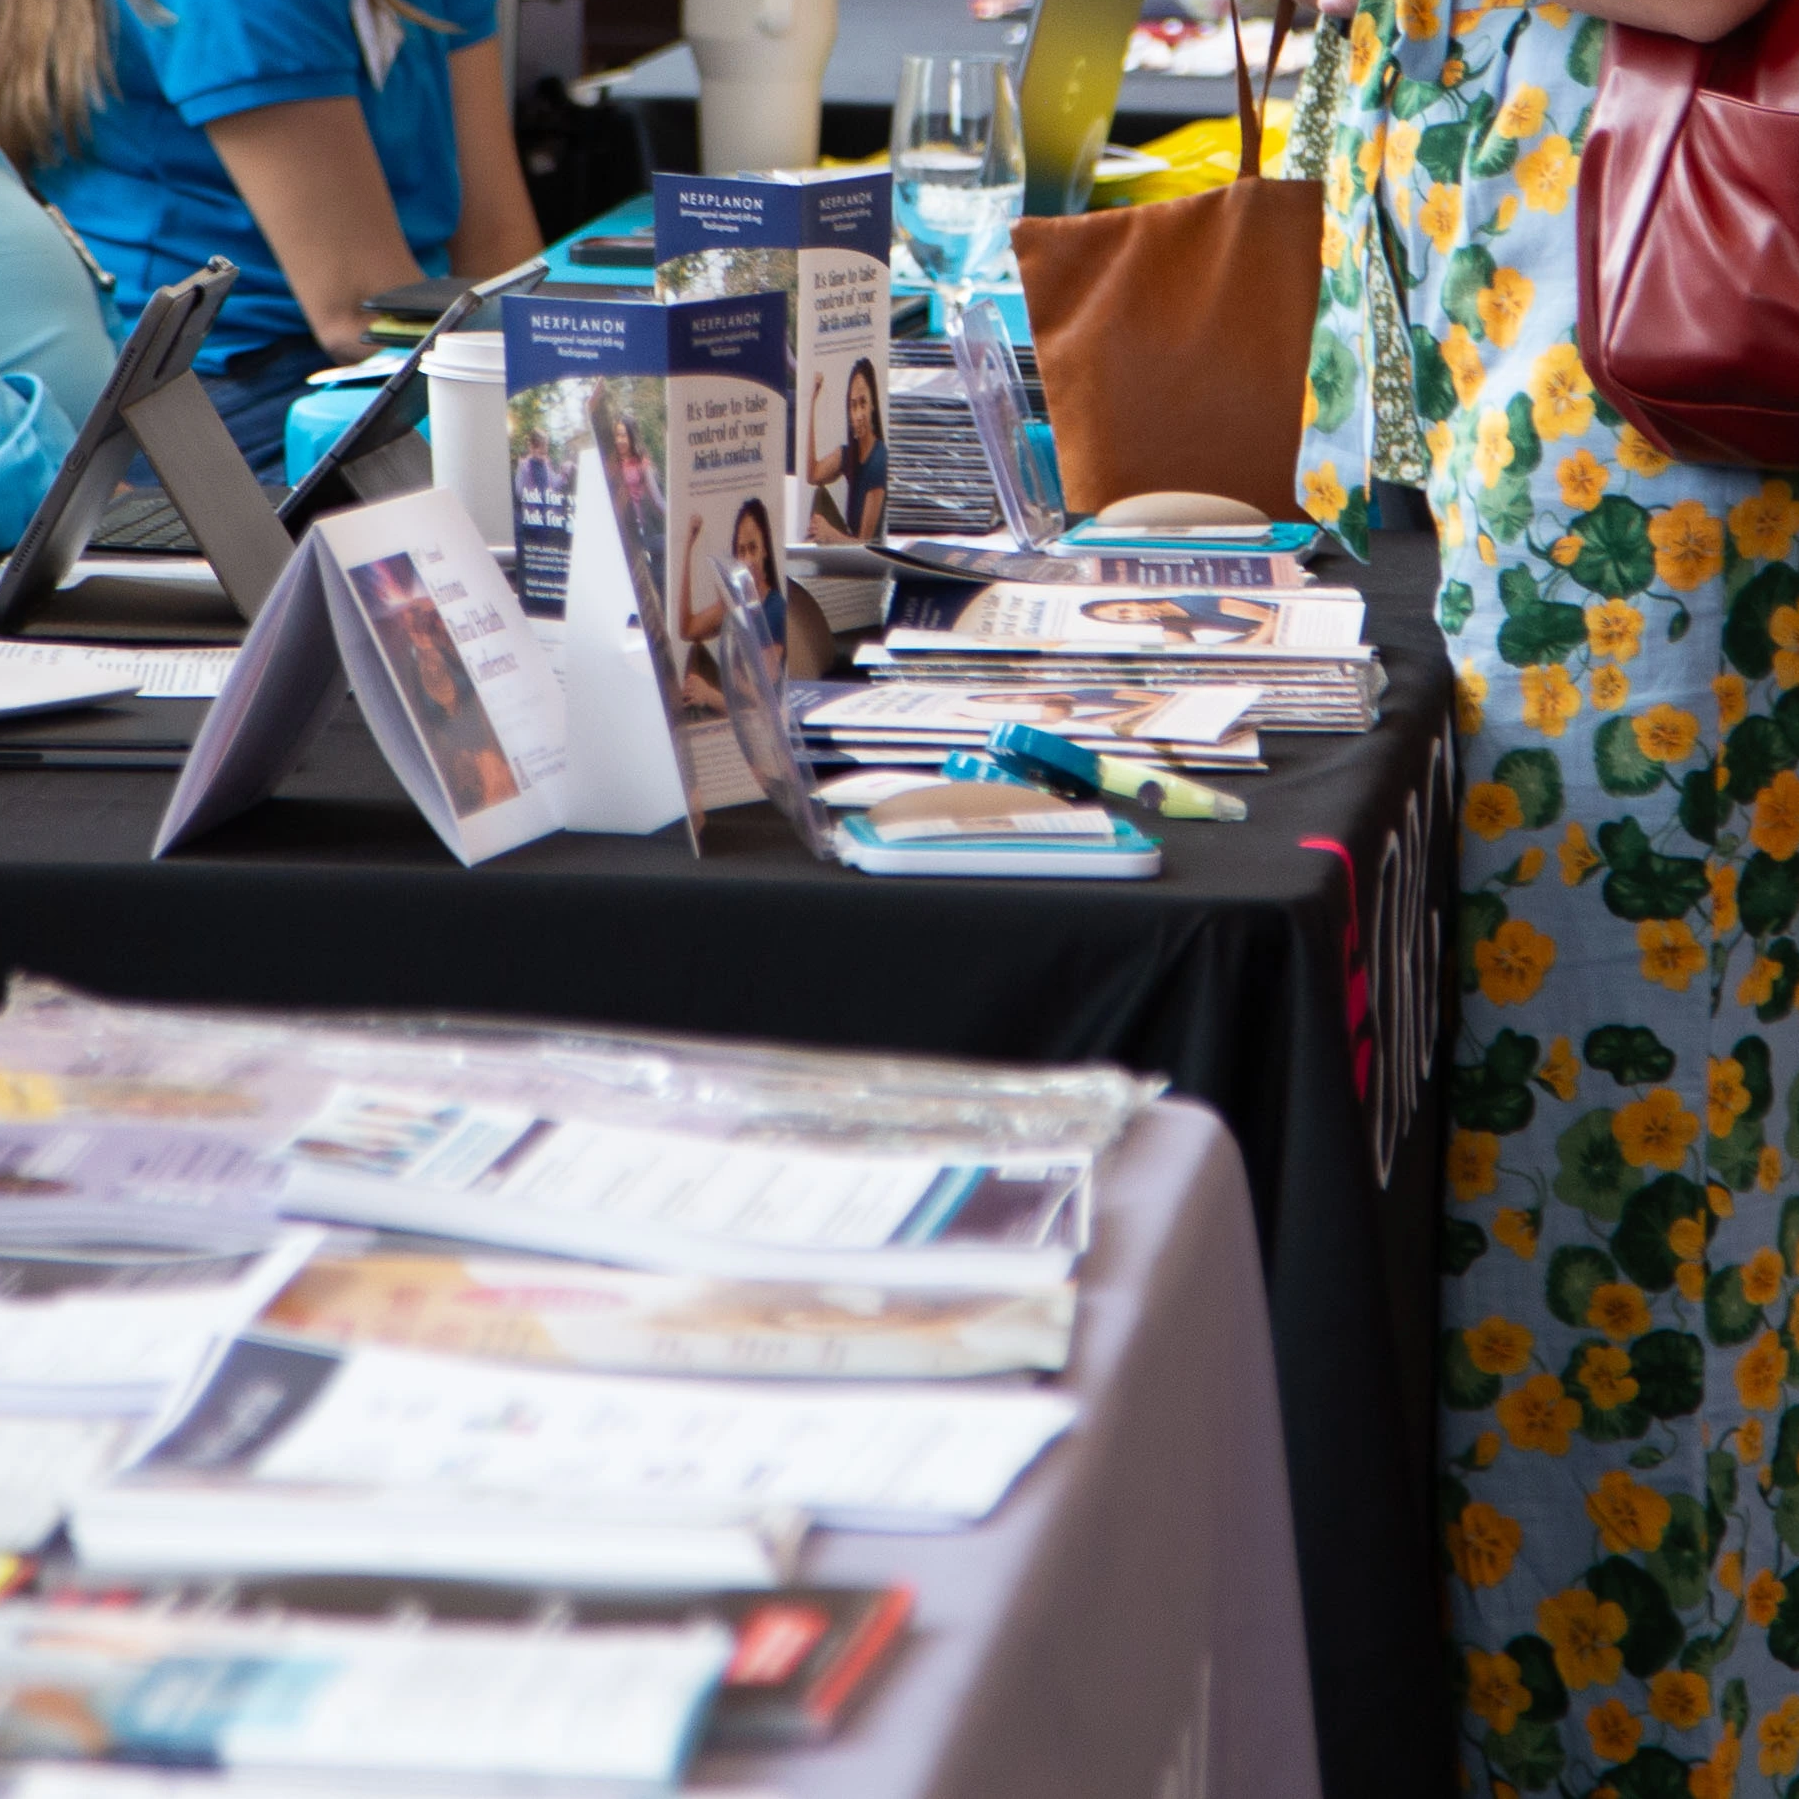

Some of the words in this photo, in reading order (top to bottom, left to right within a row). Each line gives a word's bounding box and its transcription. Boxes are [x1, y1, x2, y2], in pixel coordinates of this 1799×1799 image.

[679, 191, 764, 211] NEXPLANON
[530, 314, 626, 334] NEXPLANON
[692, 311, 762, 333] NEXPLANON
[704, 399, 728, 419] time
[729, 397, 743, 415] to
[744, 393, 768, 413] take
[688, 421, 726, 446] control
[727, 419, 743, 441] of
[522, 486, 544, 505] Ask
[545, 487, 564, 507] for
[523, 508, 545, 527] Ask
[546, 509, 566, 529] for
